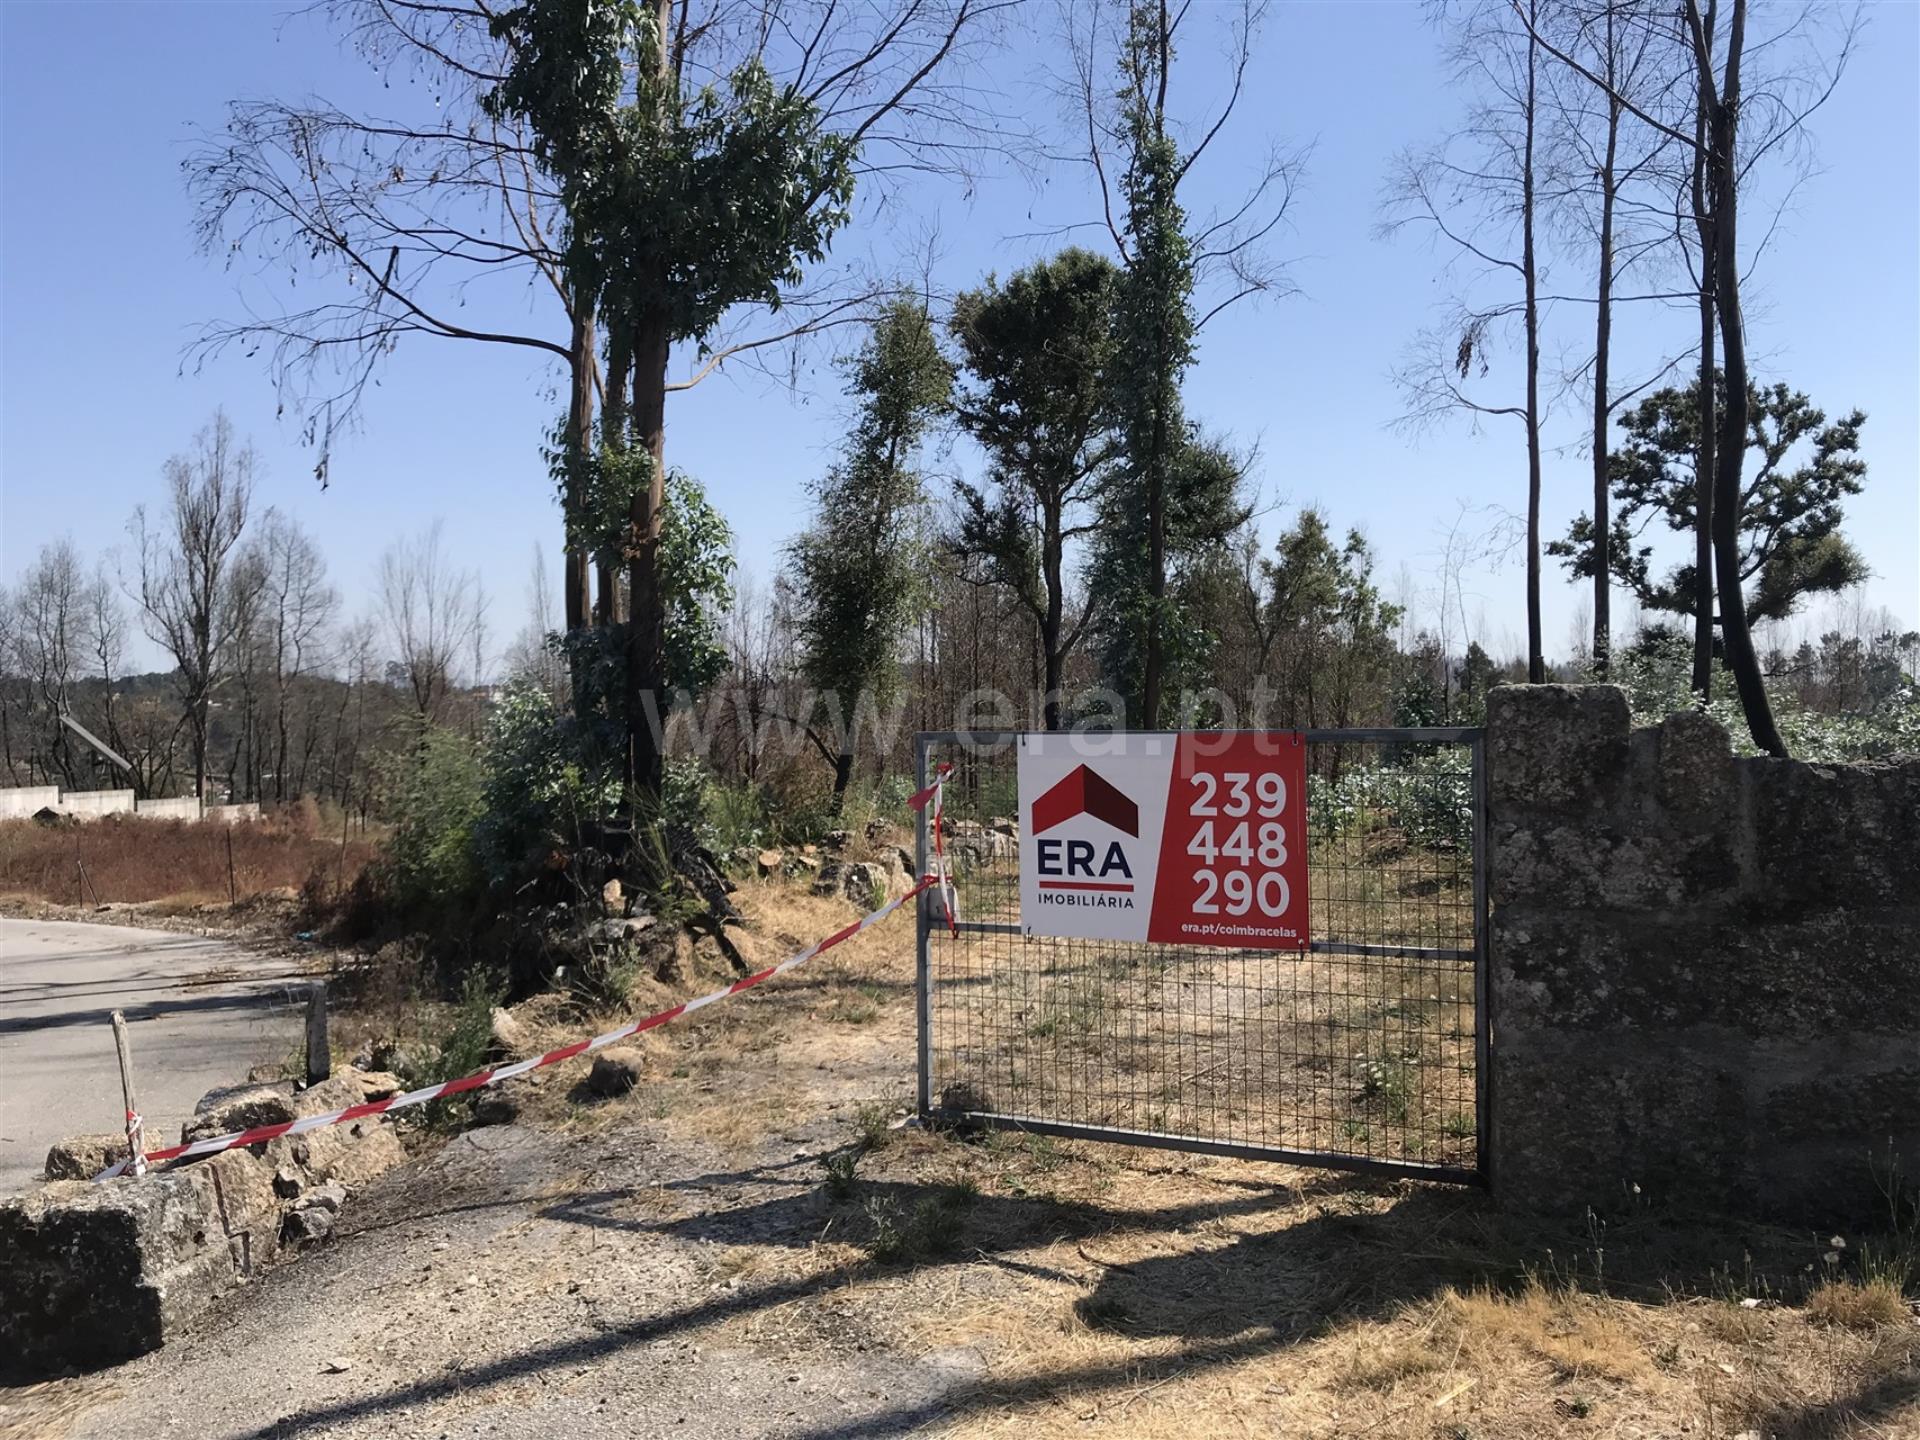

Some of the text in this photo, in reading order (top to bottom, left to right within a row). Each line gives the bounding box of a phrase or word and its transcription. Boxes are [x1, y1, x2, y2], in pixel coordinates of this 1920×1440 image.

[1189, 772, 1287, 818] 239
[1037, 839, 1133, 878] ERA
[1187, 820, 1288, 868] 448
[1038, 893, 1134, 909] IMOBILIÁRIA
[1192, 869, 1290, 918] 290
[1181, 922, 1297, 939] era.pt/coimbracelas
